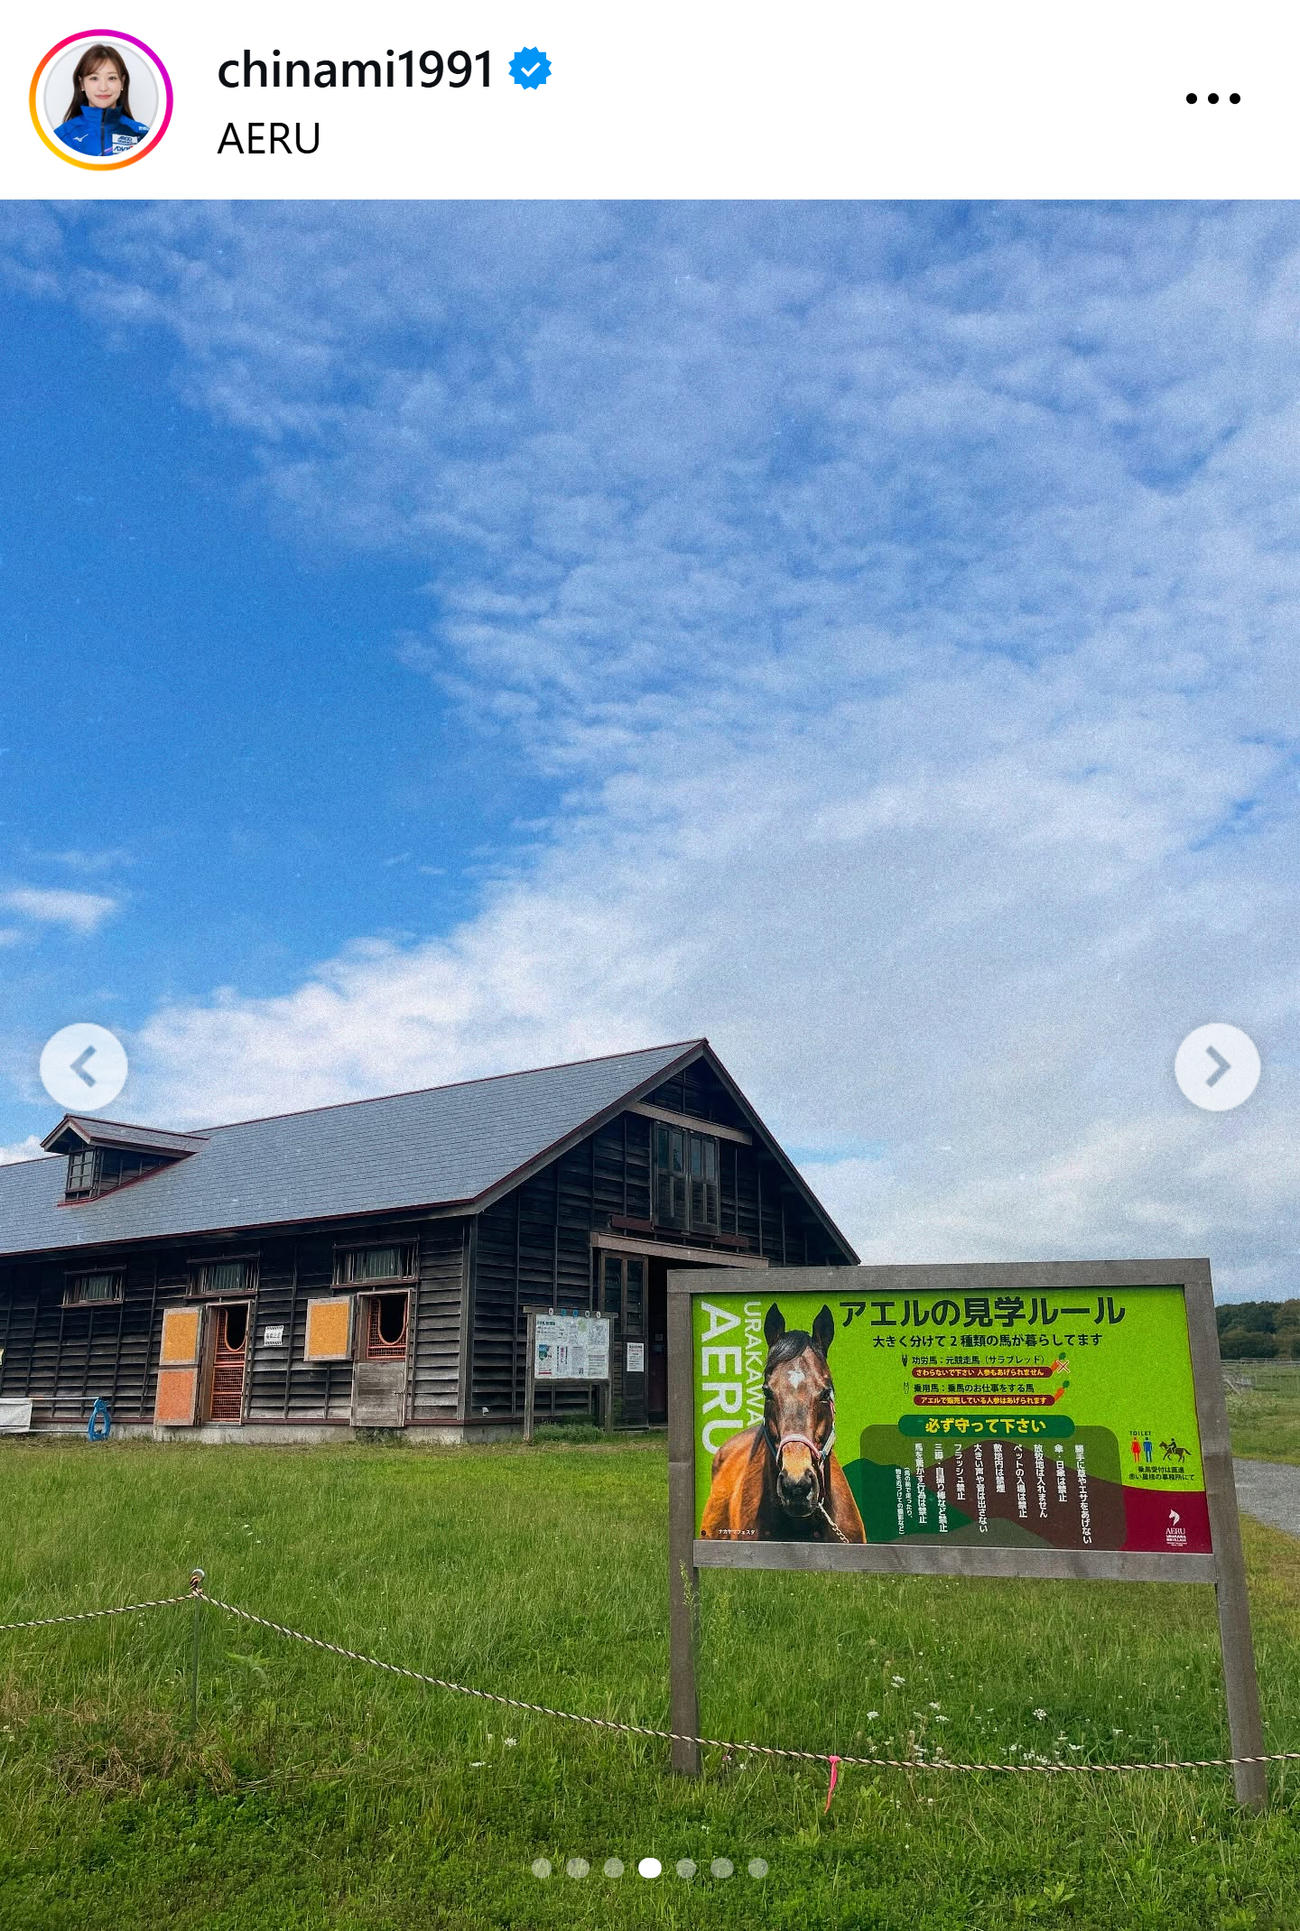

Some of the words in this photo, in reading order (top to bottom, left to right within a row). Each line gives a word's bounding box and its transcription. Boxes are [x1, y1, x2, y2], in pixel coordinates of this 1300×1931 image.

[839, 1296, 1126, 1328] アエルの見学ルール
[701, 1301, 744, 1456] AERU
[743, 1301, 766, 1427] URAKAWA
[915, 1369, 975, 1377] さわらないで下さい
[925, 1418, 1047, 1434] 必ず守って下さい
[954, 1443, 966, 1501] フラッシュ禁止
